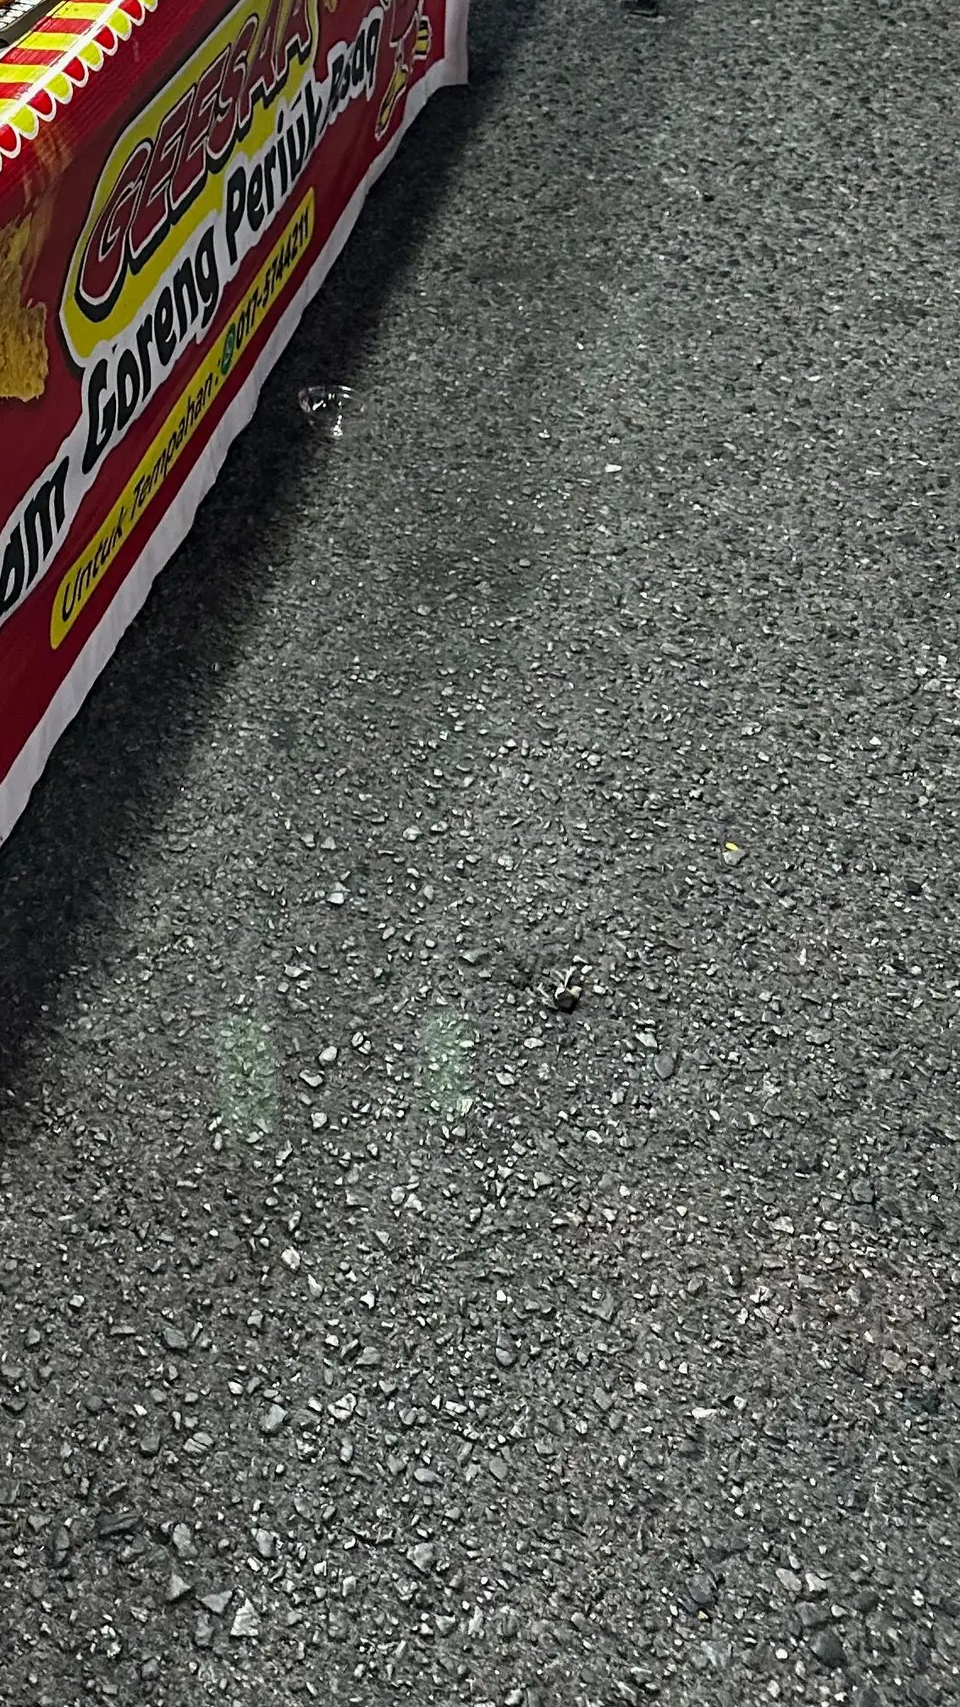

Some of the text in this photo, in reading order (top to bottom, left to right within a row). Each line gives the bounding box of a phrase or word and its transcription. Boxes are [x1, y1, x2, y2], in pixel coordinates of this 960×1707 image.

[61, 505, 127, 622] Untuk
[236, 205, 310, 350] 017-5744211
[81, 225, 220, 475] Goreng
